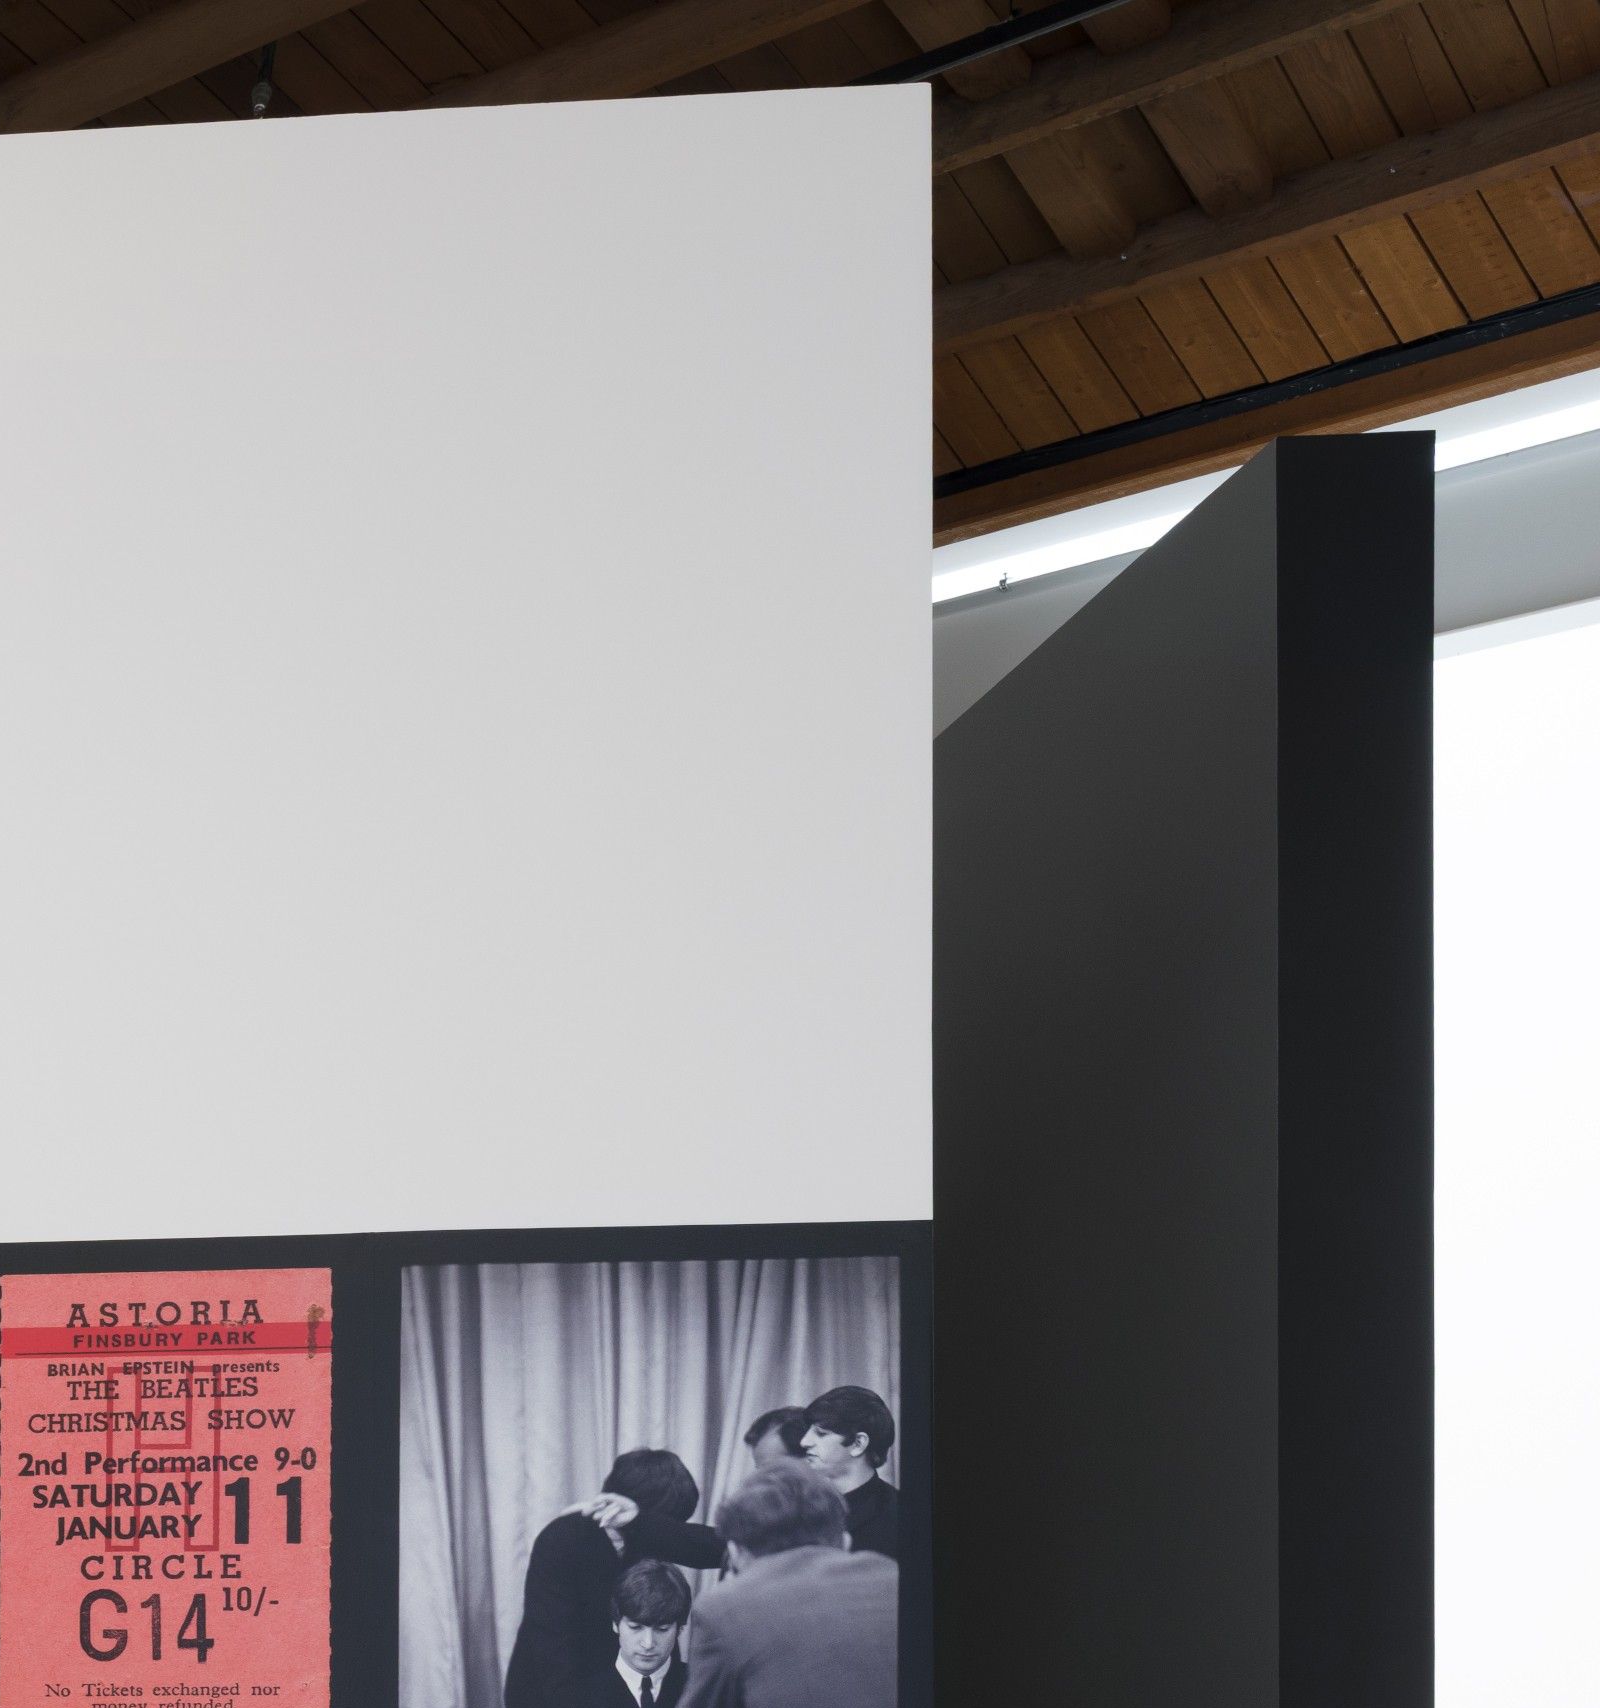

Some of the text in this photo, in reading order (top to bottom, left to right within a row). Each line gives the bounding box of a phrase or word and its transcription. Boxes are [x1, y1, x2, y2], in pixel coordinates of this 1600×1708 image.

[66, 1299, 264, 1328] ASTORIA
[73, 1332, 256, 1348] FINSBURY PARK
[48, 1360, 280, 1377] BRIAN EPSTEIN presents
[67, 1377, 259, 1400] THE BEATLES
[28, 1408, 295, 1434] CHRISTMAS SHOW
[18, 1447, 317, 1476] 2nd Performance 9-0
[33, 1482, 203, 1509] SATURDAY
[56, 1514, 203, 1546] JANUARY
[81, 1555, 242, 1581] CIRCLE
[79, 1589, 214, 1664] G14
[45, 1683, 280, 1699] No Tickets exchanged nor
